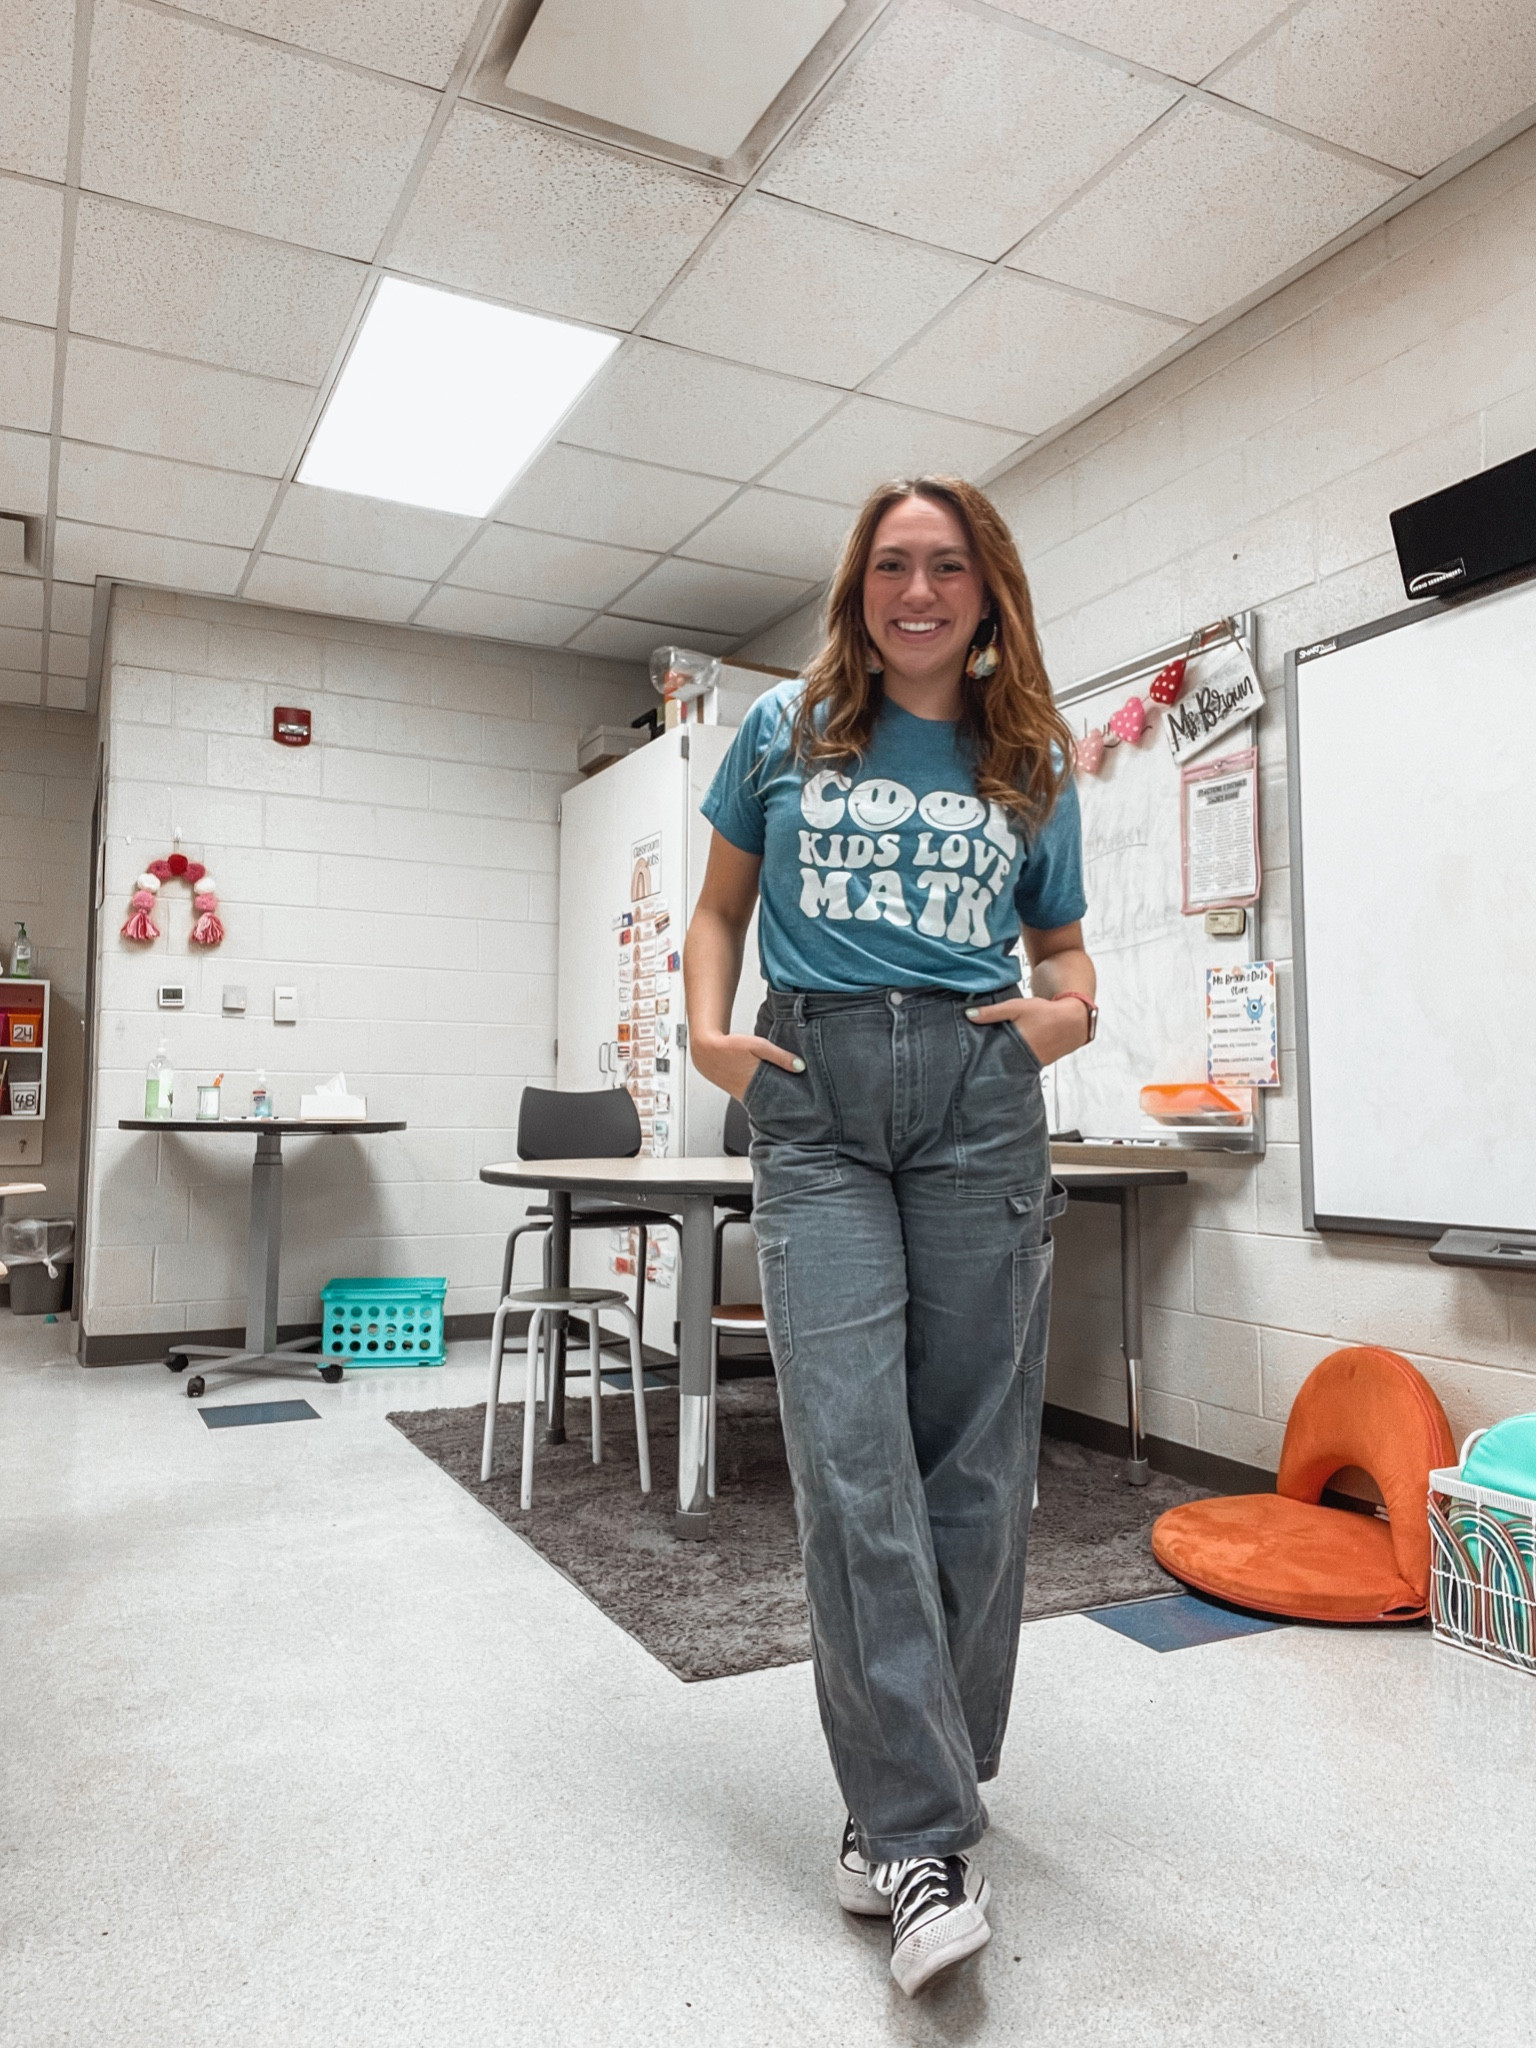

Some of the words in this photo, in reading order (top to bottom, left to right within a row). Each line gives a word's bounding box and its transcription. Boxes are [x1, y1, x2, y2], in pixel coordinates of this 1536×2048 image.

[798, 830, 901, 870] KIDS
[912, 832, 1011, 896] LOVE
[799, 867, 993, 949] MATH
[14, 1026, 32, 1041] 24
[15, 1094, 36, 1109] 48
